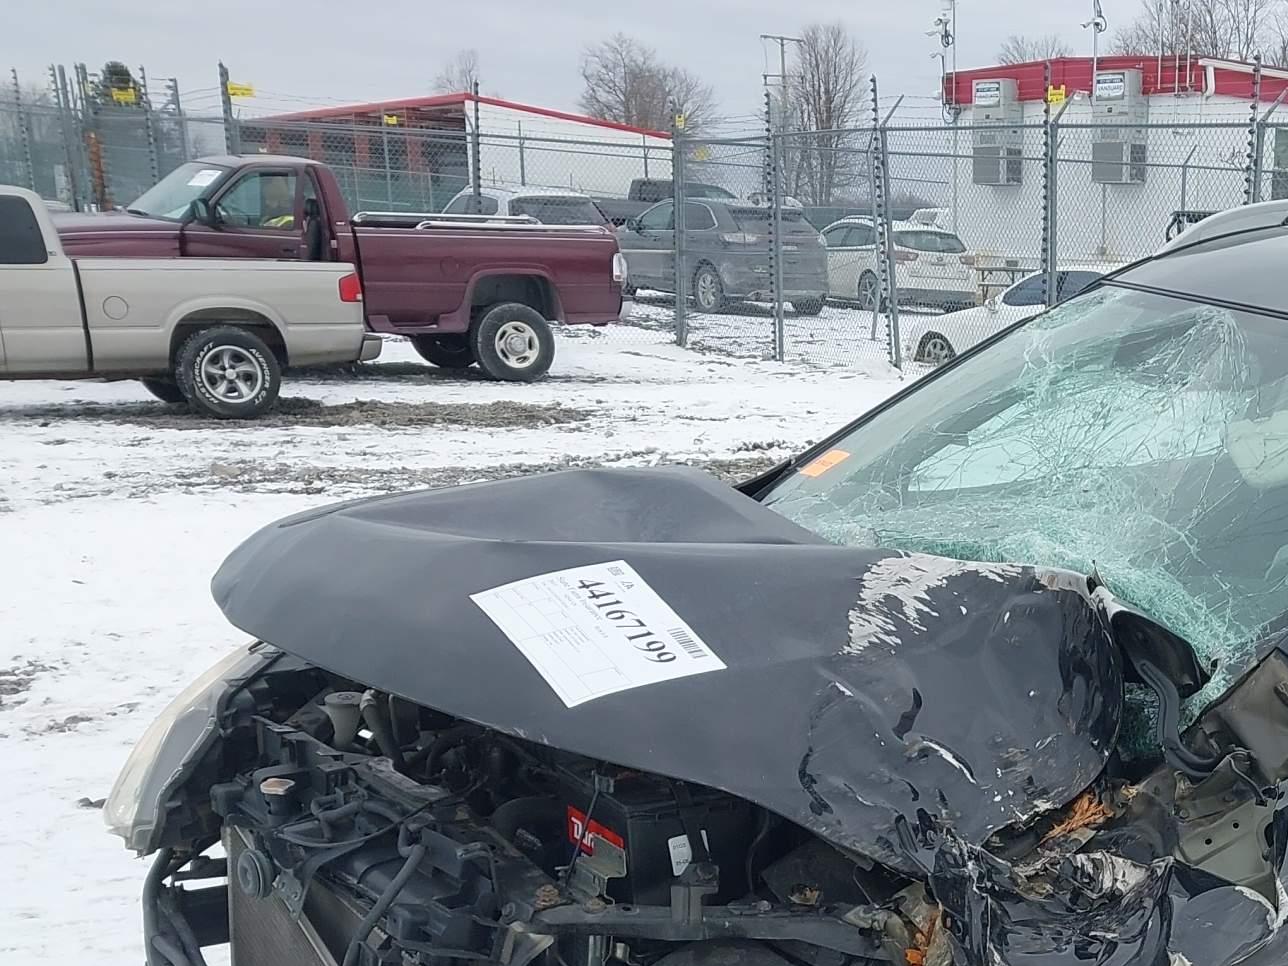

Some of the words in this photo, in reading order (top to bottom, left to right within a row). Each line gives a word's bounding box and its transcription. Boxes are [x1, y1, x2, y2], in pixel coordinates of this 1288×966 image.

[194, 341, 219, 404] MASTERCRAFT
[249, 348, 271, 389] AVENGER
[577, 579, 677, 663] 44167199
[571, 816, 594, 849] Dur
